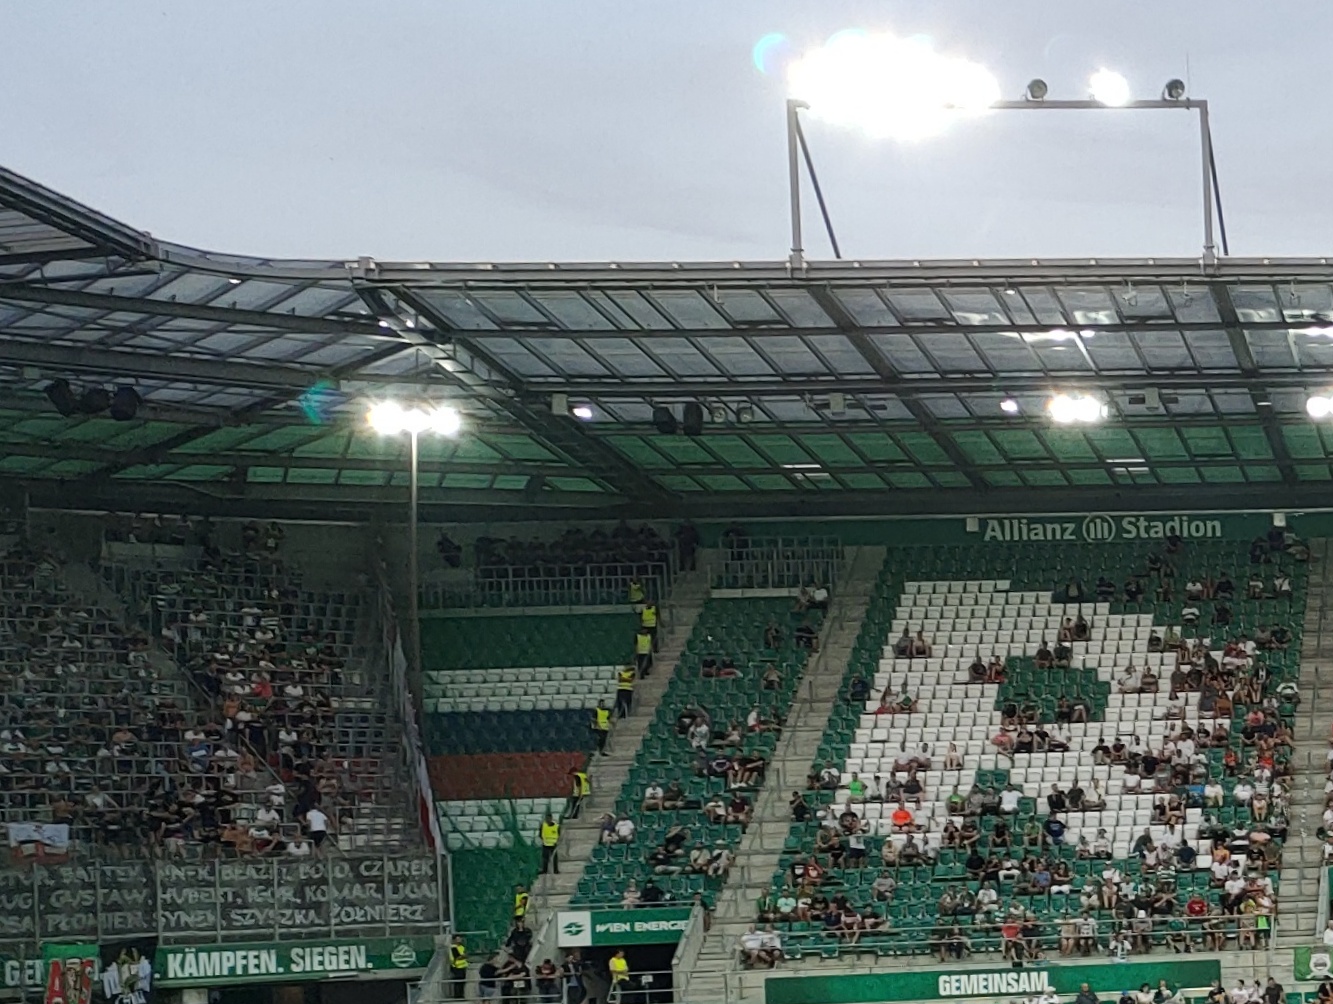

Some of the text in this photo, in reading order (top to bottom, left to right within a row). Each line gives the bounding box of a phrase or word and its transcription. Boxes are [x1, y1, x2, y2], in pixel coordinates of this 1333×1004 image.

[983, 515, 1222, 542] Allianz Stadion
[596, 919, 689, 933] WIEN ENERGIE
[167, 948, 285, 979] KÄMPFEN.
[290, 945, 374, 972] SIEGEN.
